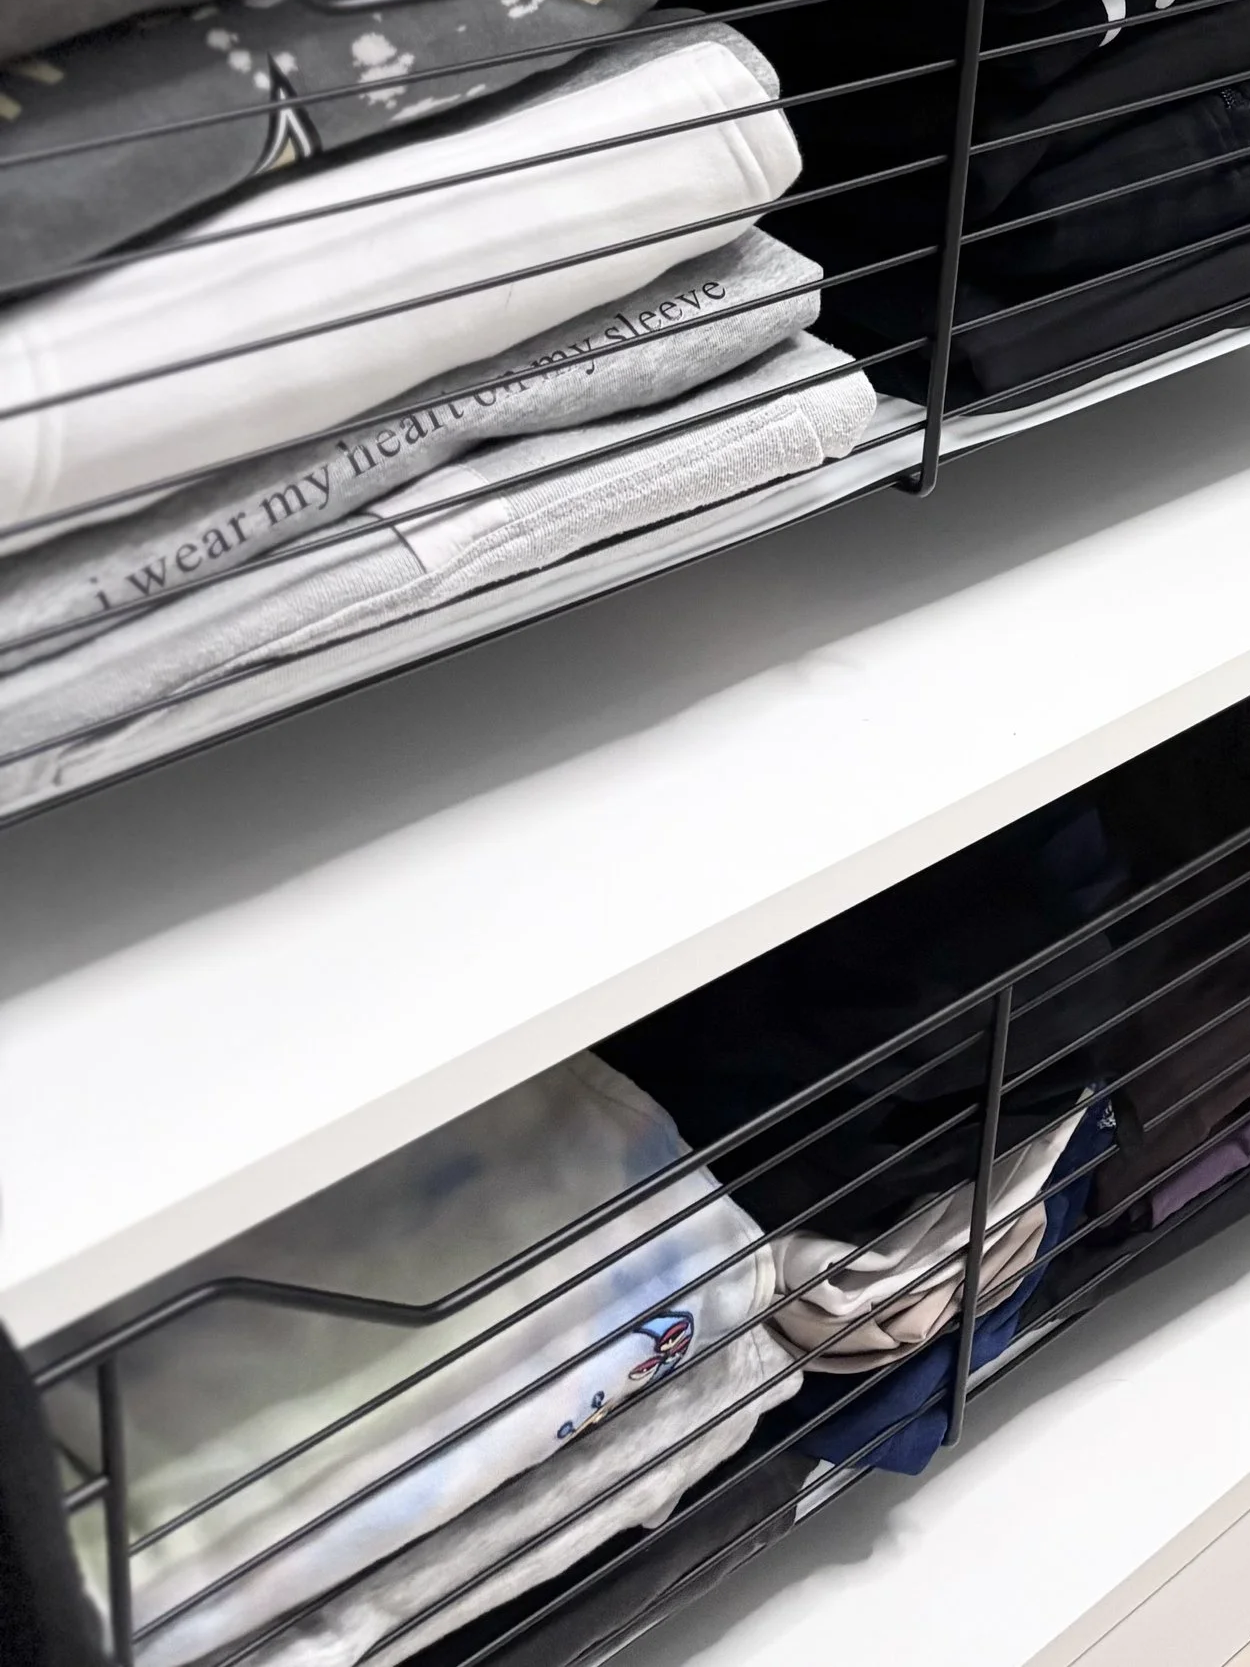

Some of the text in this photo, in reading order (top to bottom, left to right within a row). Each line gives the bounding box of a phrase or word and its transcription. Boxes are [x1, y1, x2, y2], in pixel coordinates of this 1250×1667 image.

[125, 509, 248, 597] wear
[258, 462, 331, 526] my
[336, 390, 466, 479] heart
[604, 279, 727, 345] sleeve
